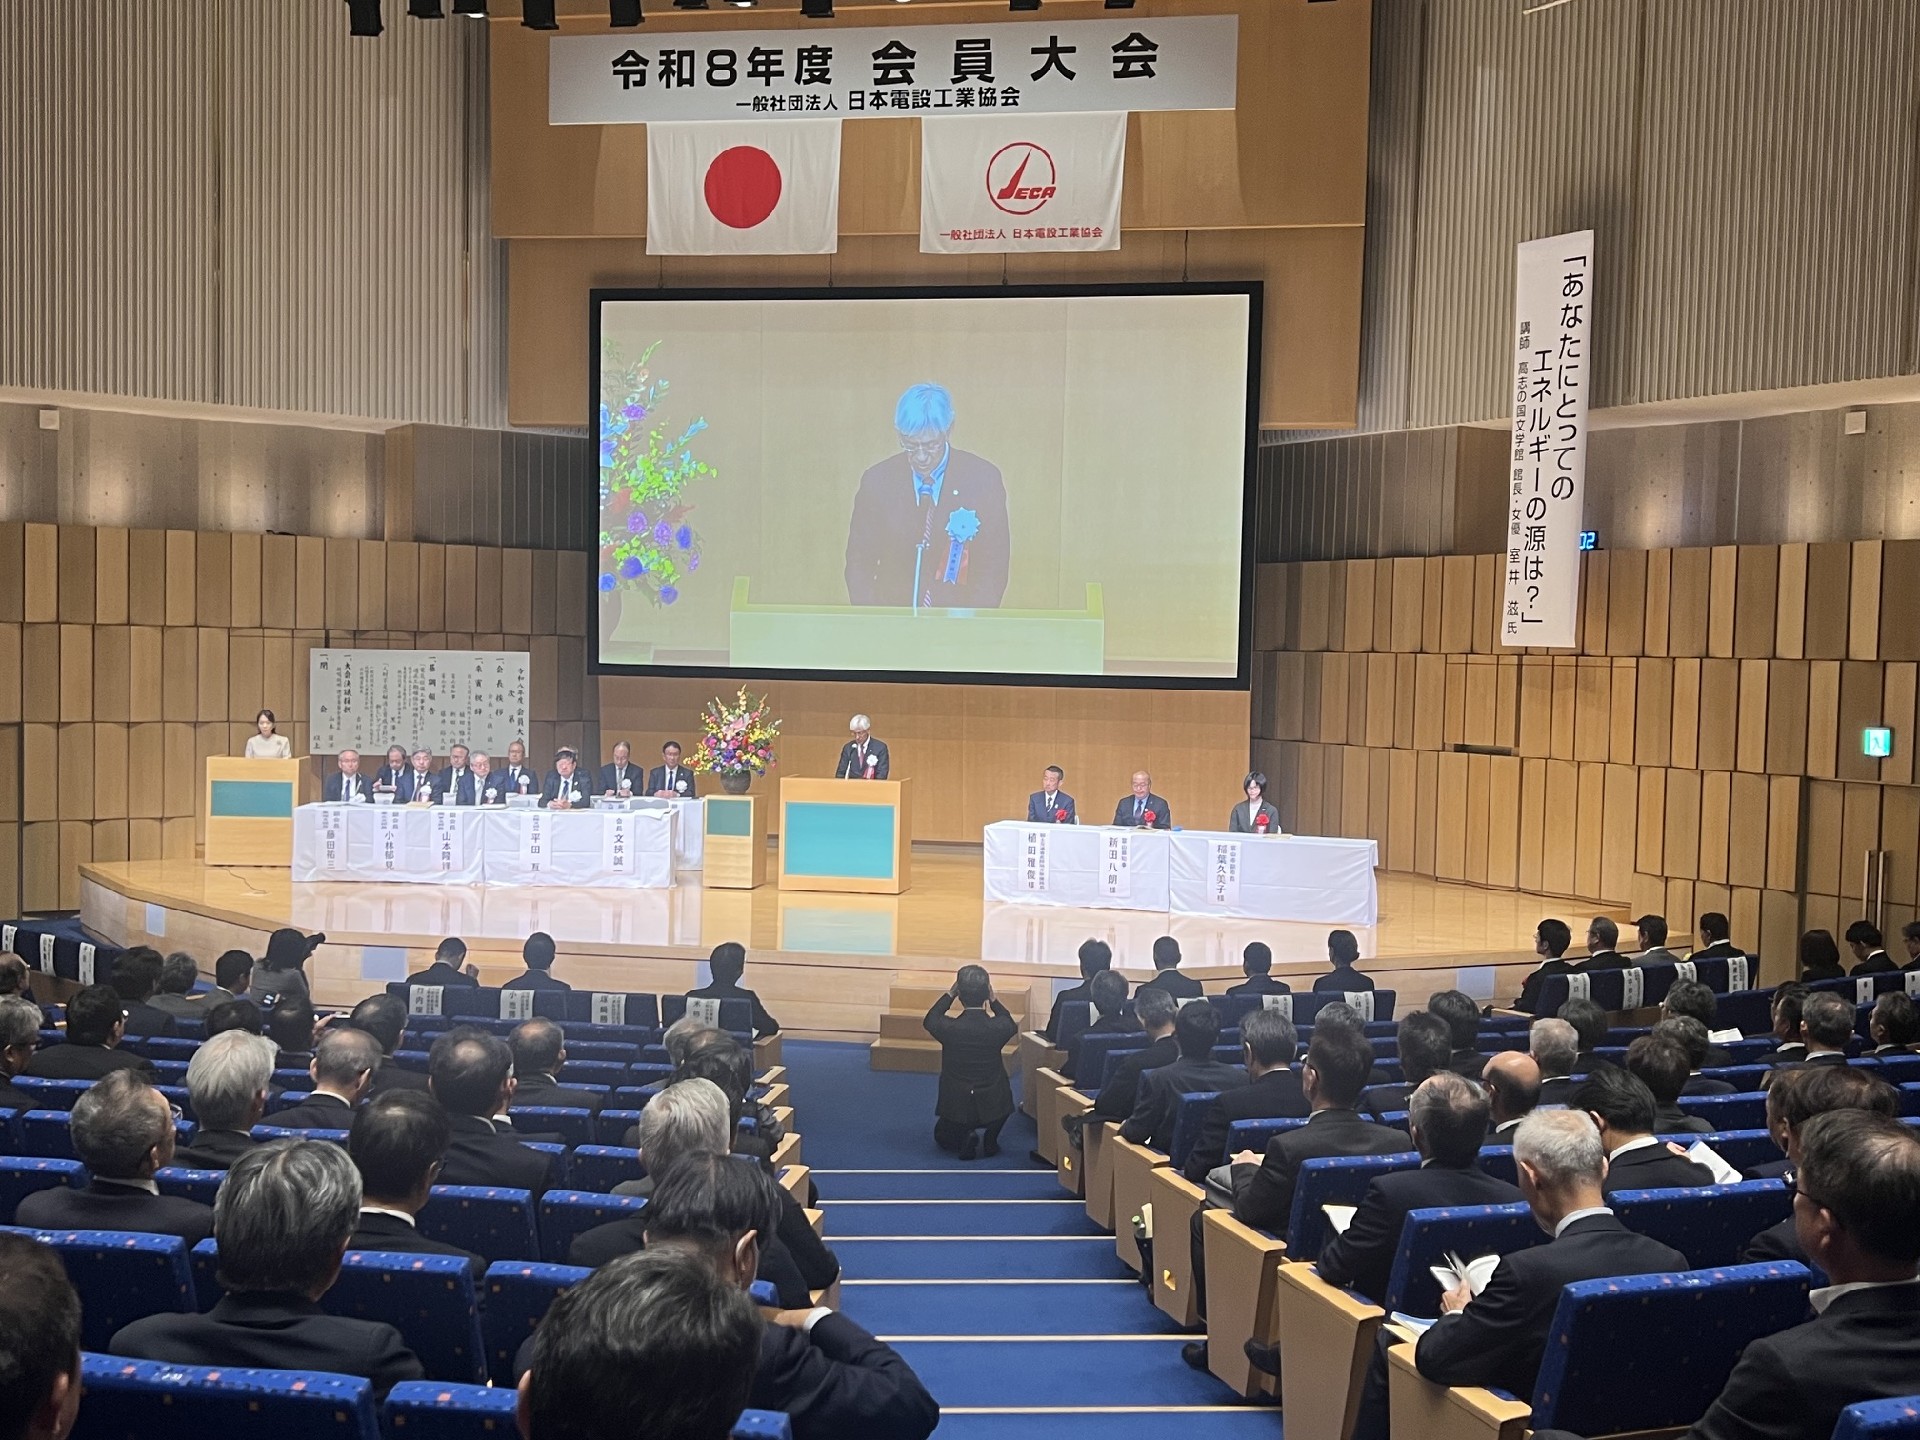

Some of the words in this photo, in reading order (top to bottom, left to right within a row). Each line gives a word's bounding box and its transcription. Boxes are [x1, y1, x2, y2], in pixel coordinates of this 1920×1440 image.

[611, 44, 833, 89] 令和8年度
[872, 32, 1160, 86] 会員大会
[736, 94, 838, 112] 一般社団法人
[849, 86, 1020, 111] 日本電設工業協会
[997, 148, 1056, 199] JECA
[940, 228, 1006, 241] 一般社団法人
[1013, 227, 1103, 239] 日本電設工業協会
[1519, 321, 1531, 350] 講師
[1551, 254, 1587, 501] 「あなたにとっての
[1513, 361, 1529, 461] 高志の国文学館
[1521, 350, 1553, 624] エネルギーの源は？」
